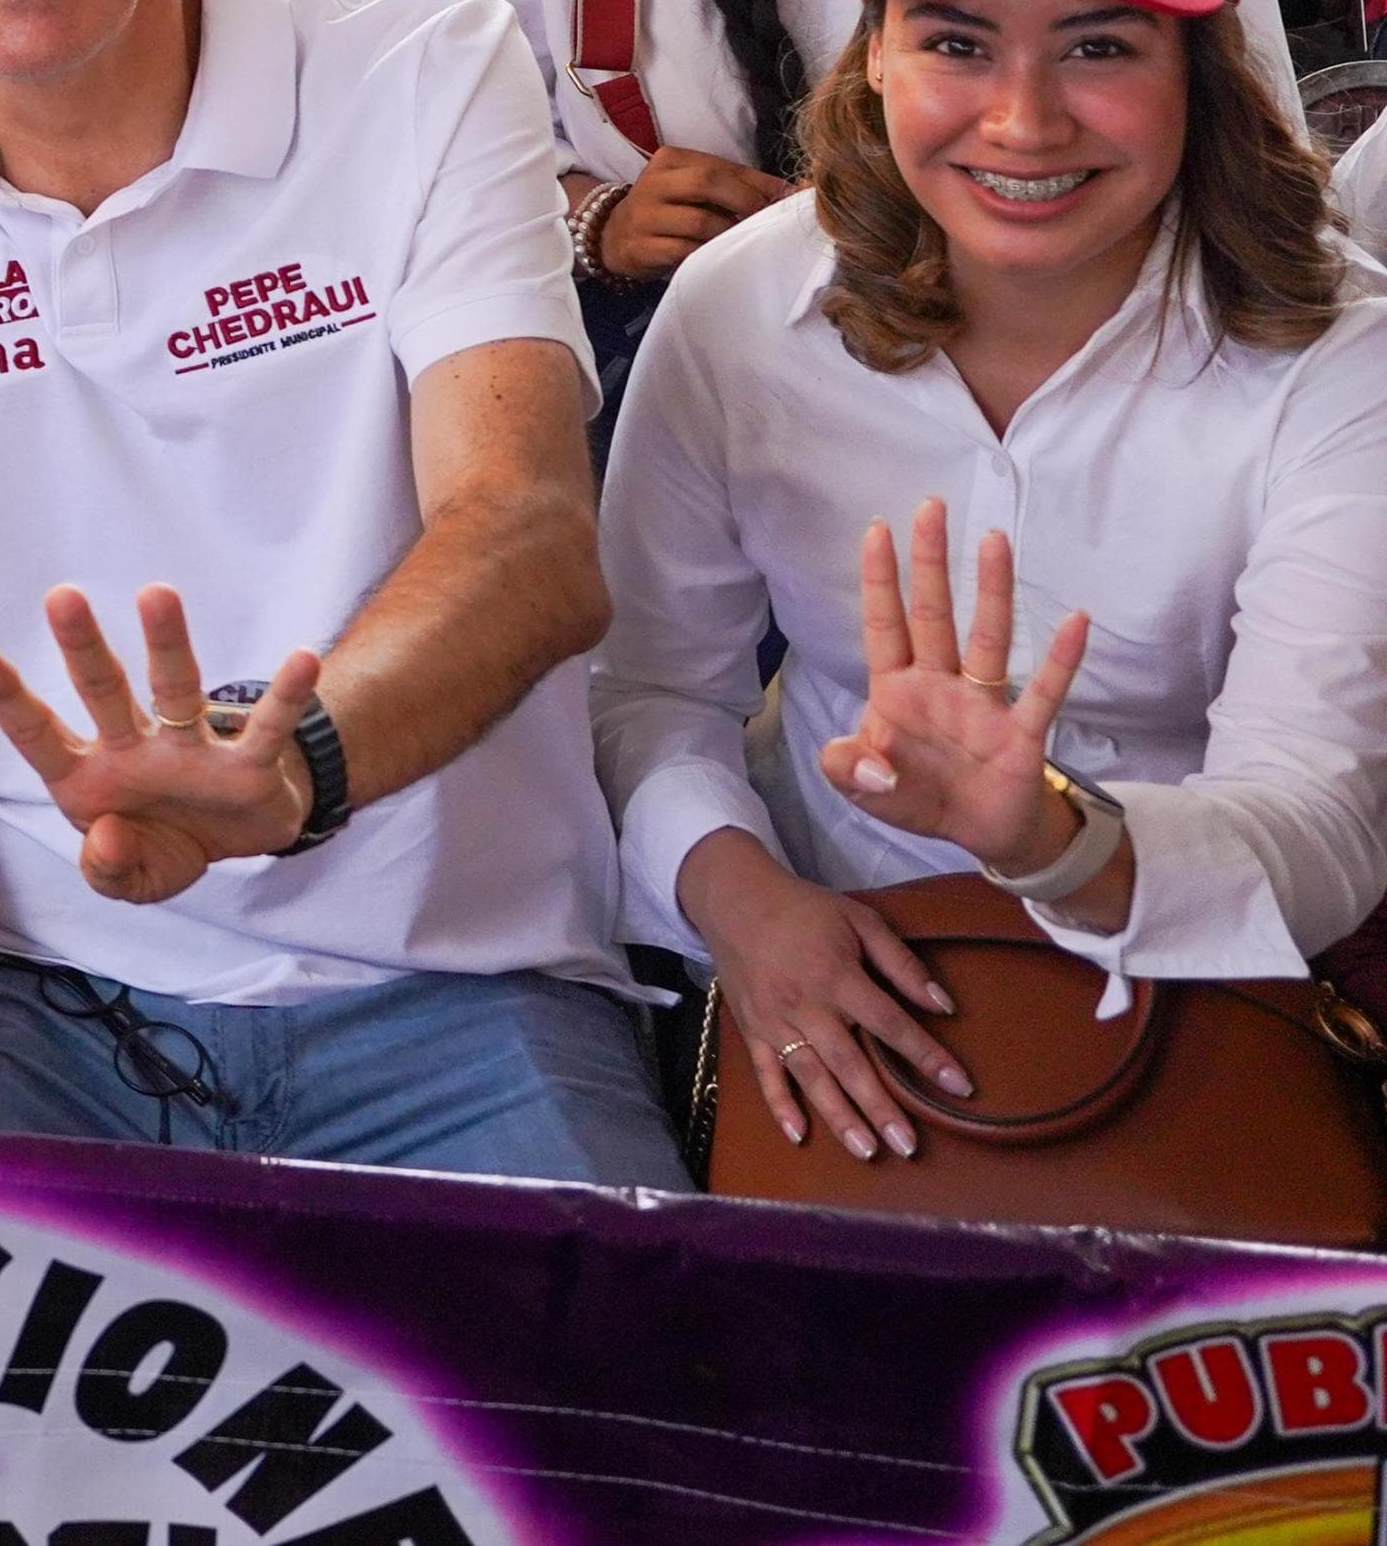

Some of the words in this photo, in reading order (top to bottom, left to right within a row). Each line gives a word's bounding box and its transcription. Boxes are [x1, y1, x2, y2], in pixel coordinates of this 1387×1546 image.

[204, 262, 307, 317] PEPE
[167, 276, 370, 359] CHEDRAUI
[211, 341, 277, 369] PRESIDENTE
[280, 323, 341, 349] MUNICIPAL
